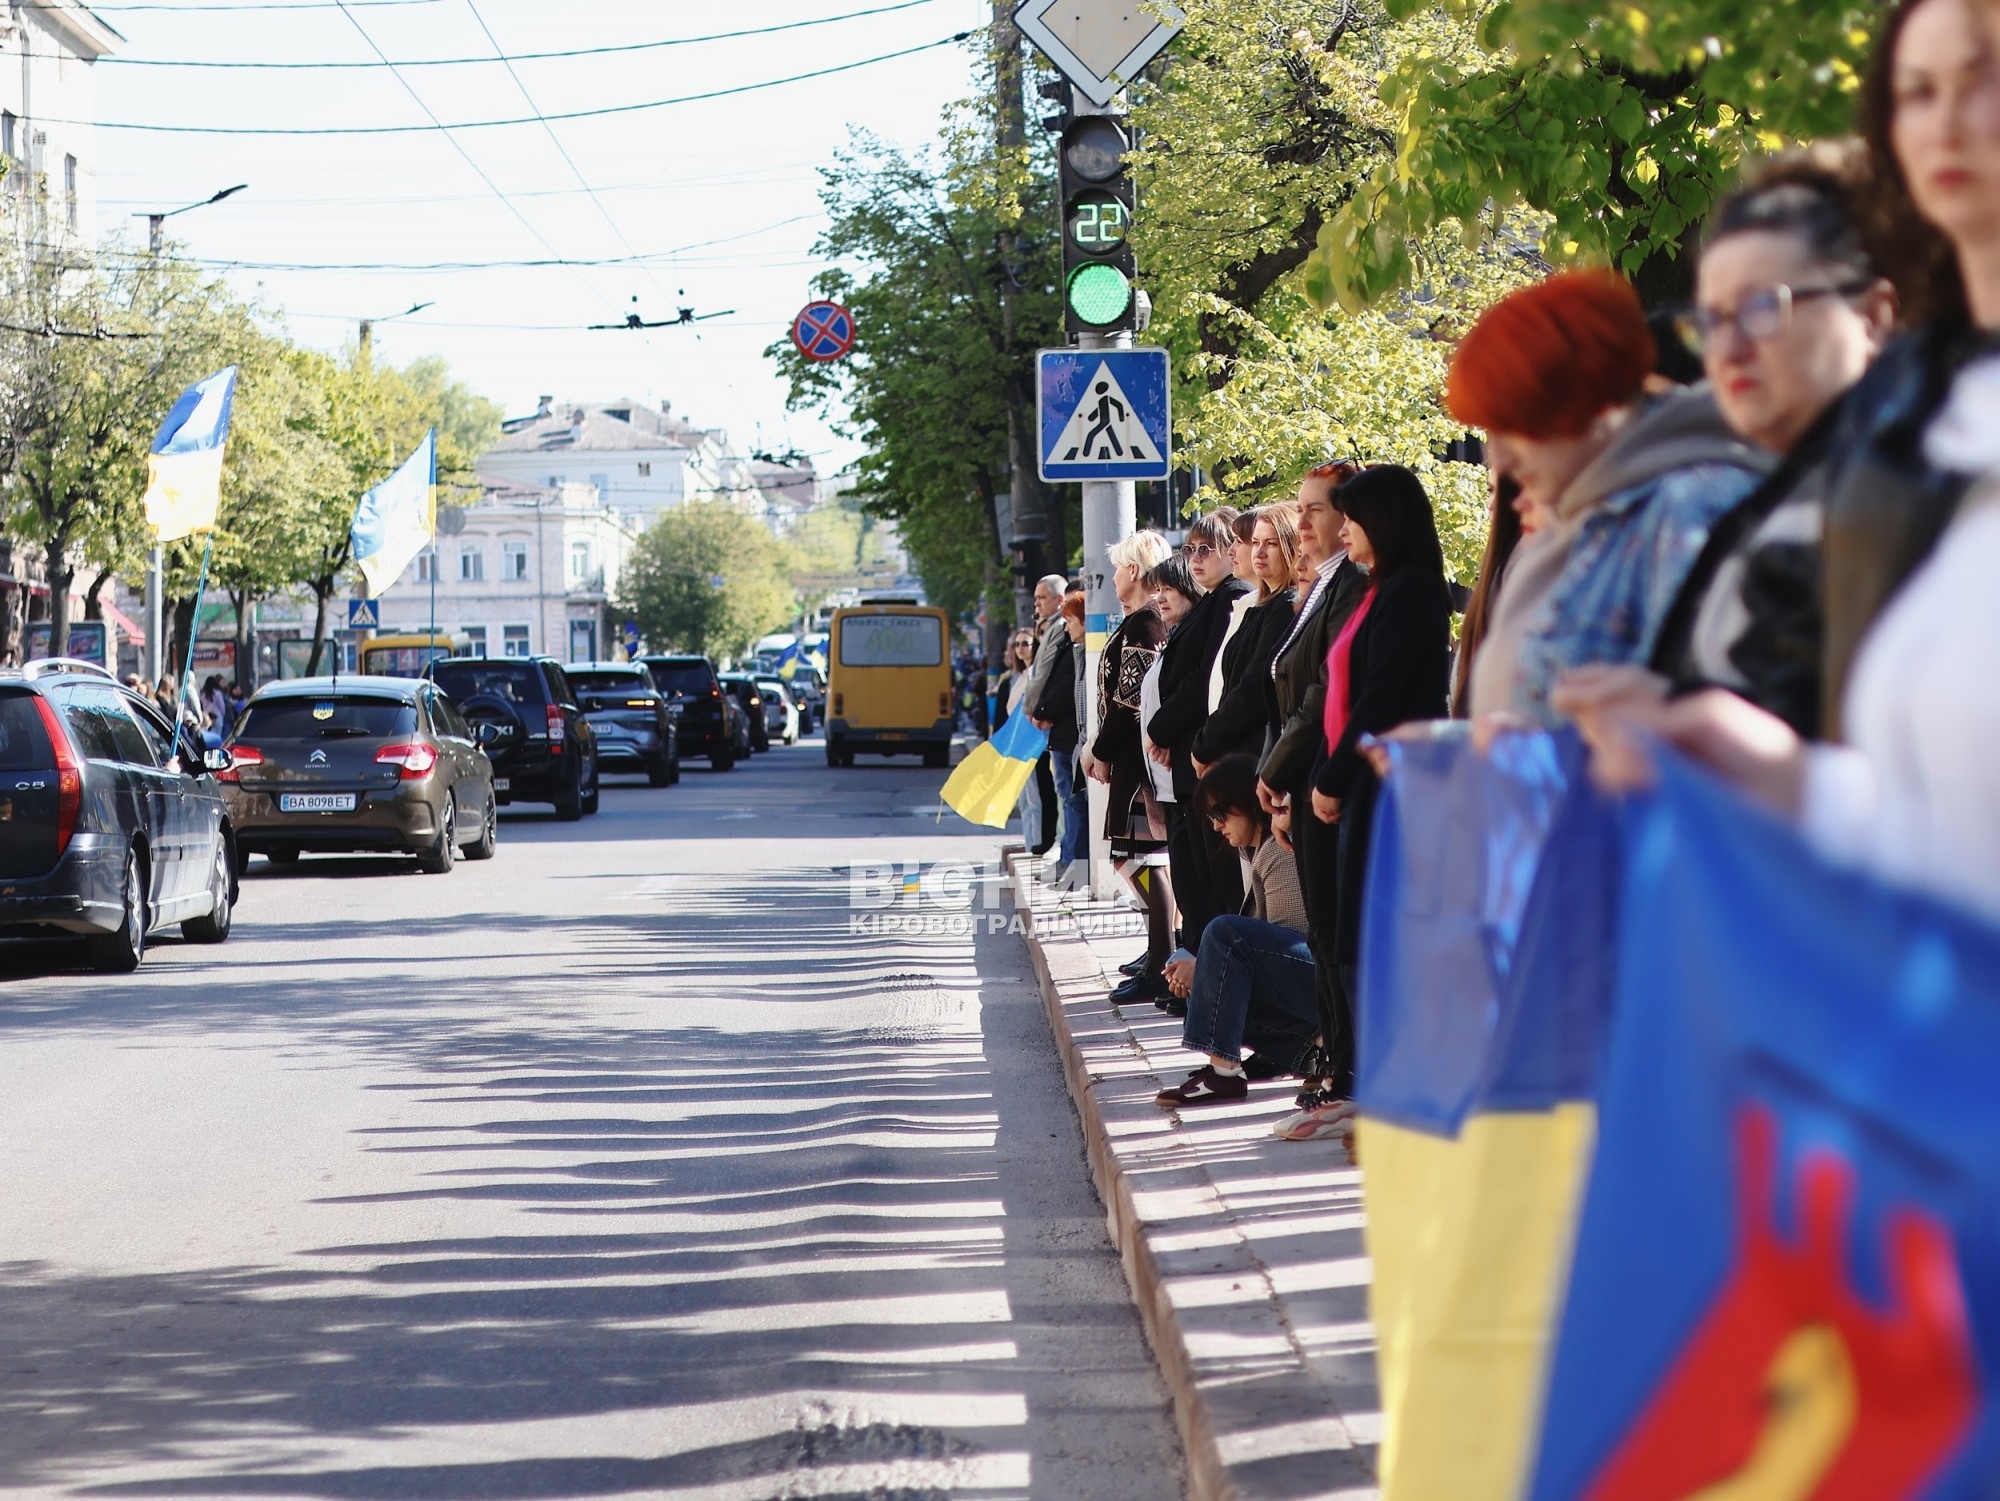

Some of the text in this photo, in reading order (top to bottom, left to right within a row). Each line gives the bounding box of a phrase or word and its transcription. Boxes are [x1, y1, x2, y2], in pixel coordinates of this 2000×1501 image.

[1075, 204, 1122, 241] 22
[401, 649, 414, 668] 4
[15, 781, 46, 791] C5
[289, 796, 352, 808] BA 8098 ET
